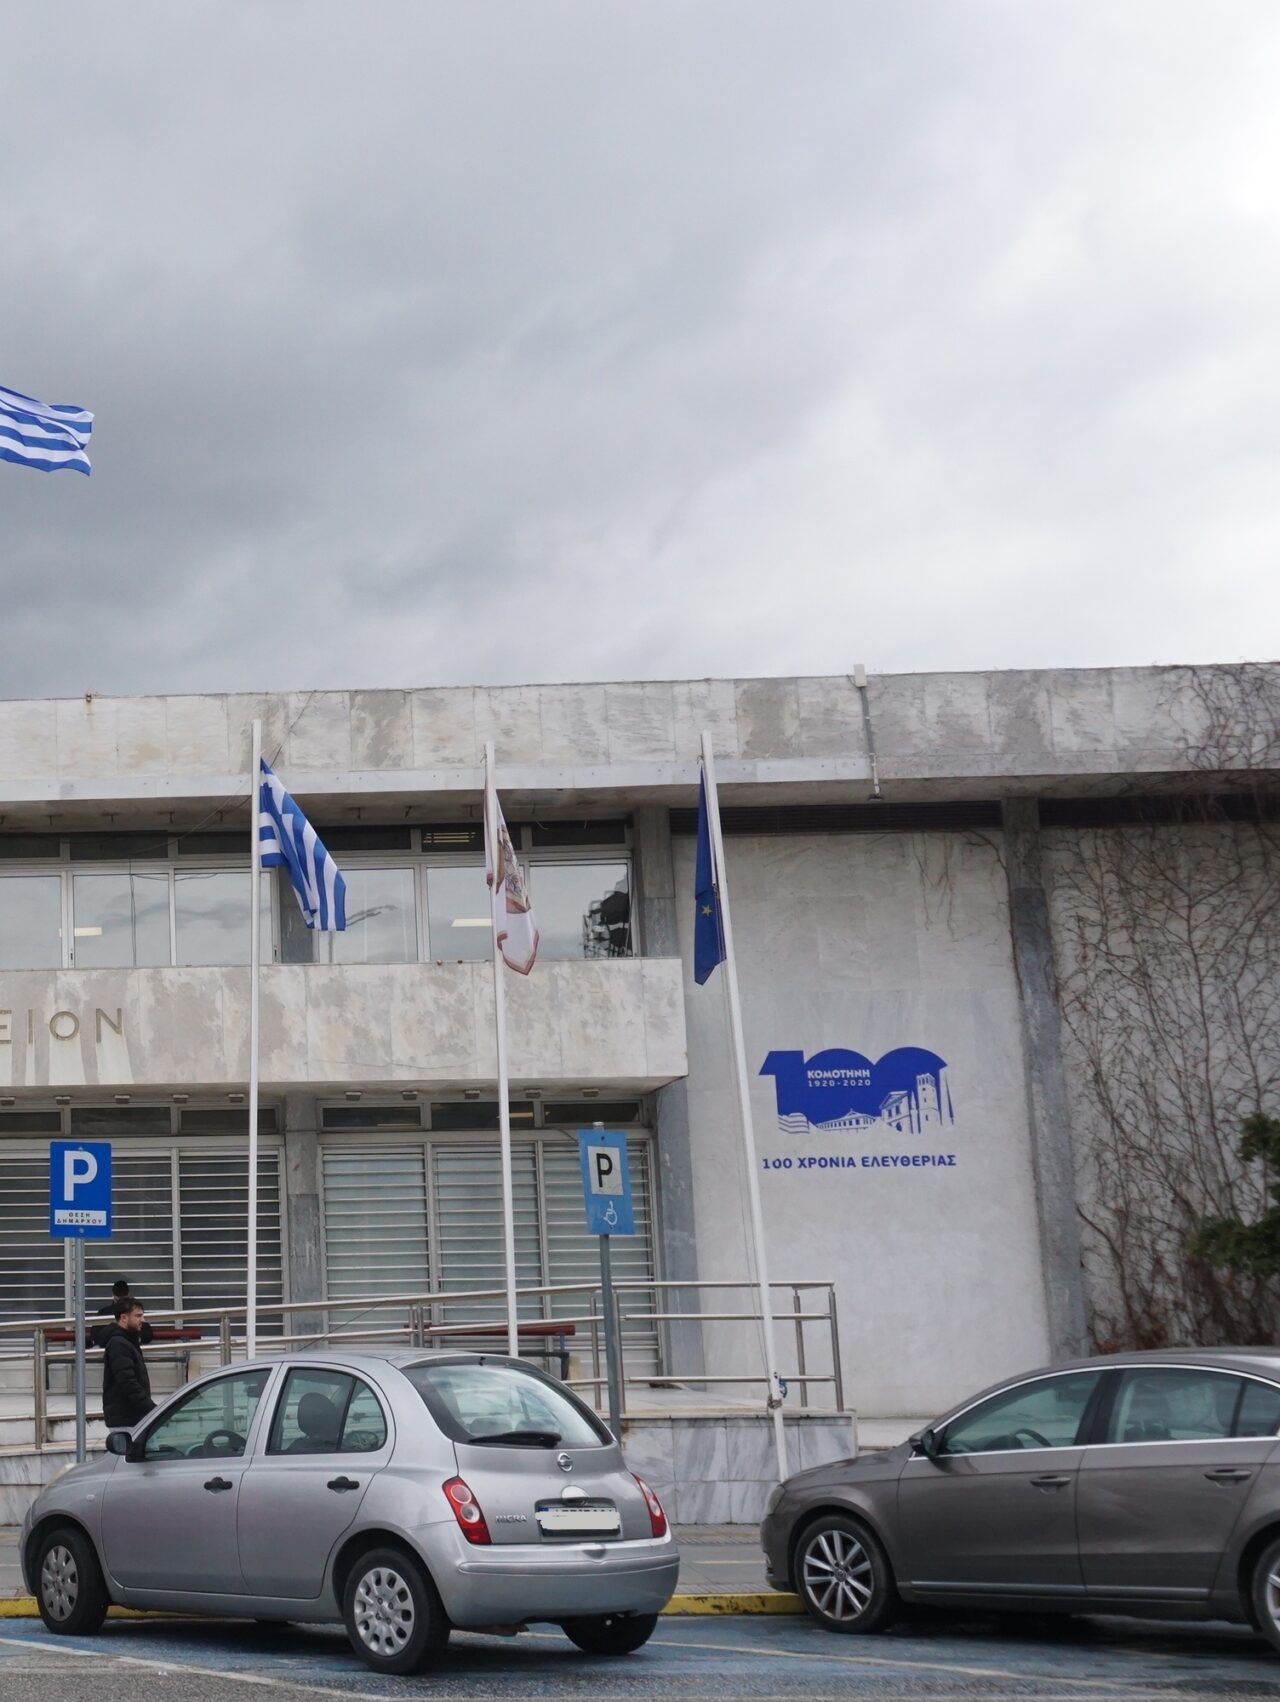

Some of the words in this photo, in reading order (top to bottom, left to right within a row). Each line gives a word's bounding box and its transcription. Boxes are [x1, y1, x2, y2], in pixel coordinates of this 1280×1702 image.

[807, 1069, 870, 1079] ΚΟΜΟΤΗΝΗ
[808, 1079, 871, 1087] 1920-2020
[763, 1158, 792, 1169] 100
[798, 1157, 856, 1169] ΧΡΟΝΙΑ
[861, 1155, 957, 1168] ΕΛΕΥΘΕΡΙΑΣ
[63, 1150, 98, 1201] P
[596, 1153, 613, 1188] P
[496, 1514, 527, 1523] MICRA
